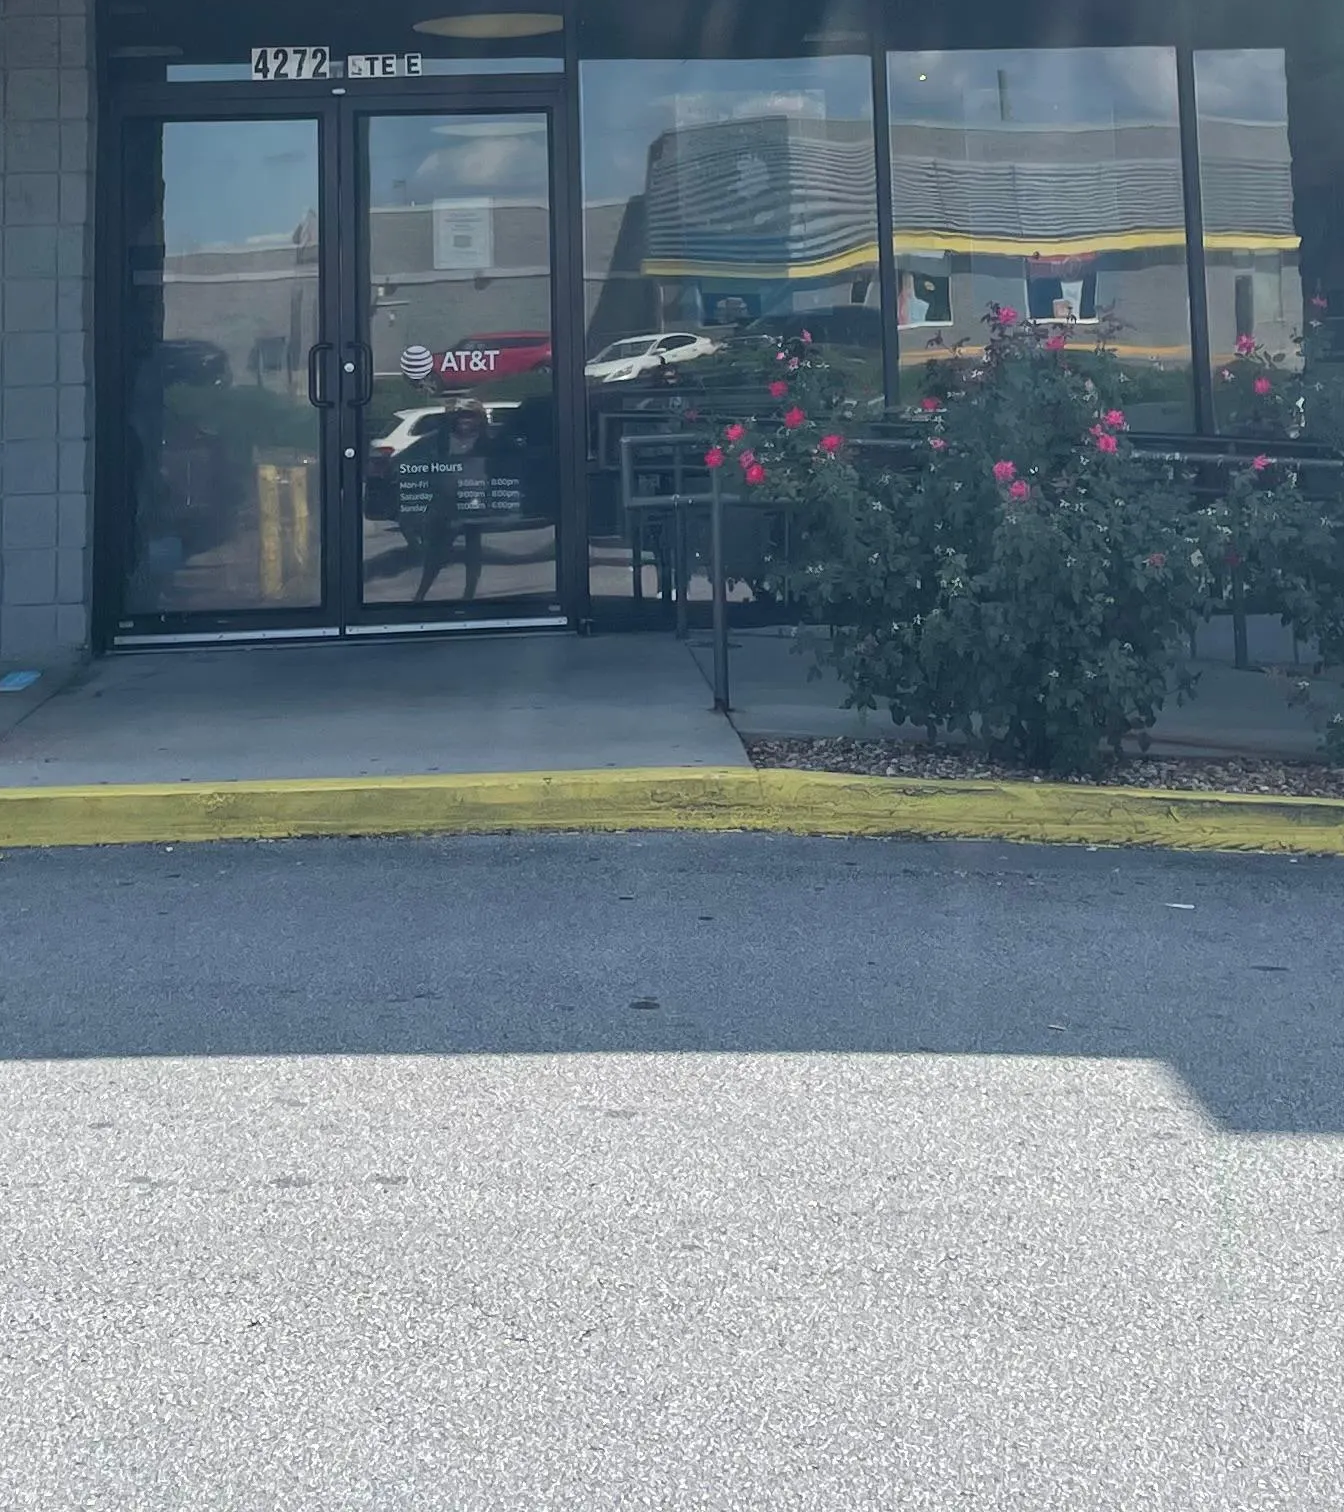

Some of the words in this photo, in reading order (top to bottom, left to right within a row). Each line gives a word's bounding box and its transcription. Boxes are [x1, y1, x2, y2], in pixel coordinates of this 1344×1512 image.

[254, 47, 328, 80] 4272
[407, 54, 421, 76] E
[440, 349, 500, 373] AT&T
[399, 463, 429, 474] Store
[431, 462, 463, 473] Hours
